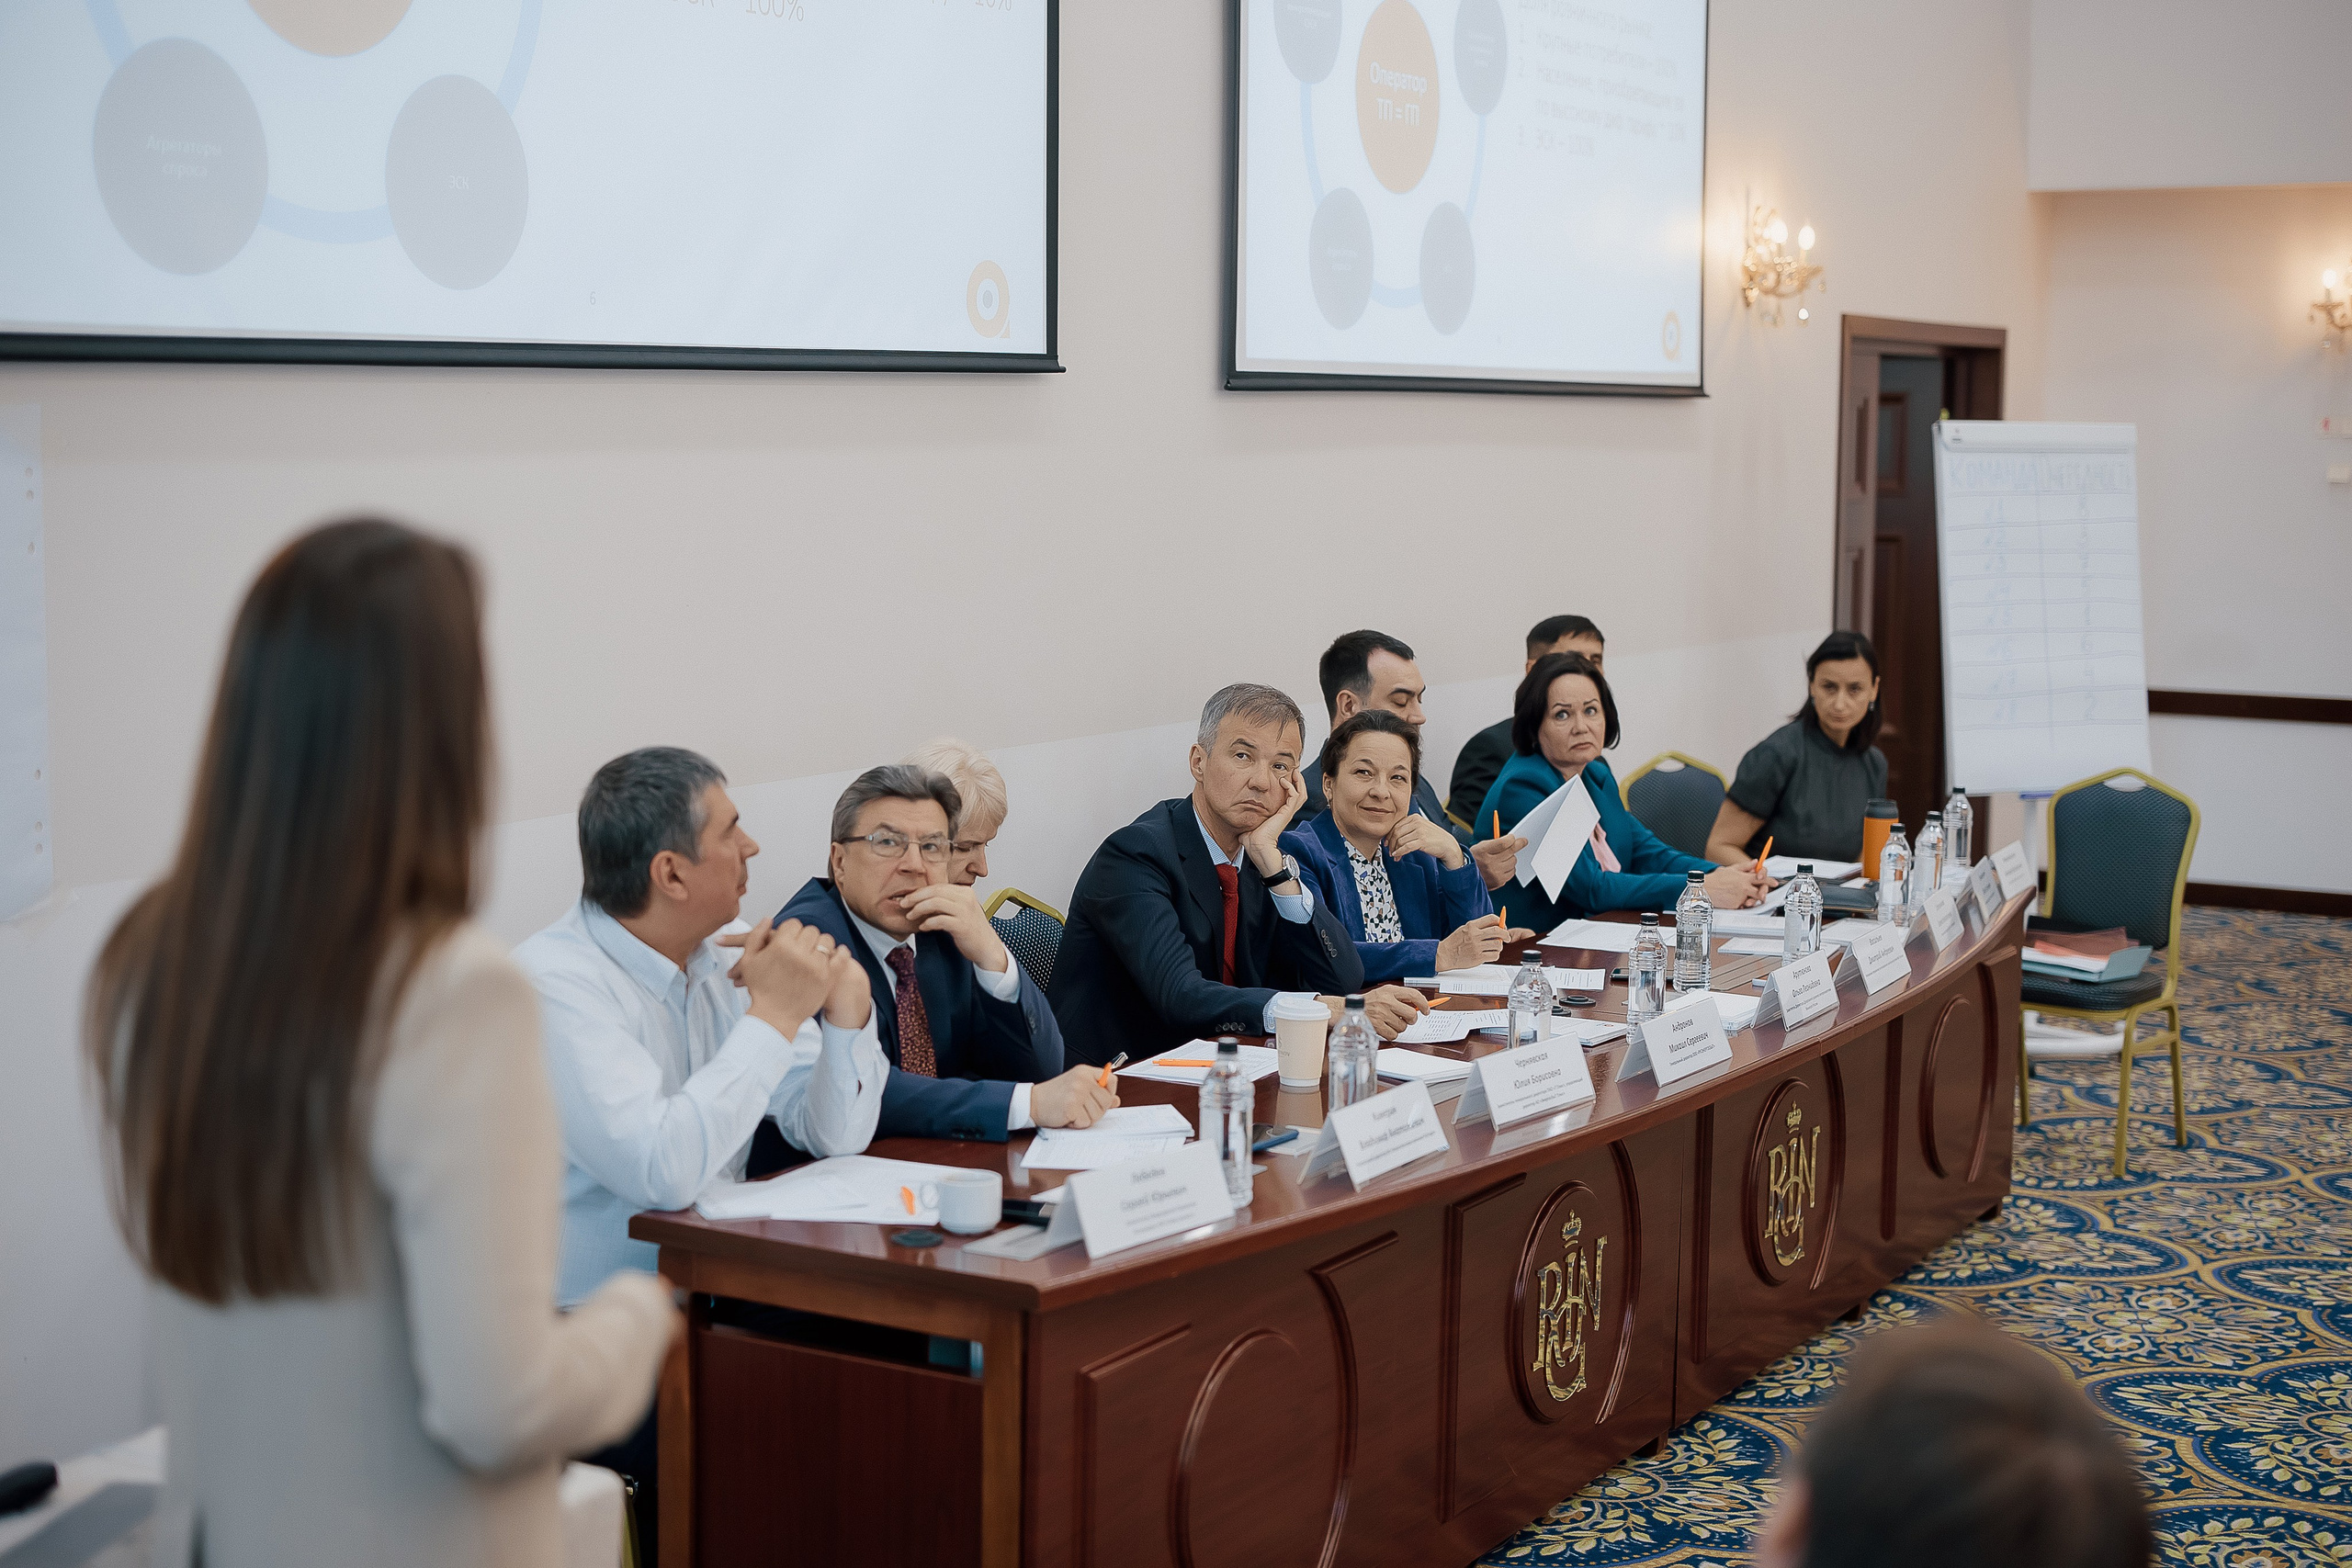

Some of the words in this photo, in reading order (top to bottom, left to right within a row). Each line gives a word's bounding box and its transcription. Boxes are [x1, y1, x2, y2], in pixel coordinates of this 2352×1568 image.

[1369, 62, 1428, 97] Оператор
[145, 134, 222, 158] Агрегаторы
[162, 162, 209, 179] спроса
[448, 175, 469, 190] ЭСК
[589, 290, 597, 306] 6
[1671, 1018, 1694, 1032] Андронов
[1668, 1040, 1687, 1054] Михаил
[1686, 1032, 1709, 1046] Сергеевич
[1514, 1052, 1549, 1068] Чернявская
[1513, 1078, 1531, 1089] Юлия
[1531, 1068, 1562, 1084] Борисовна
